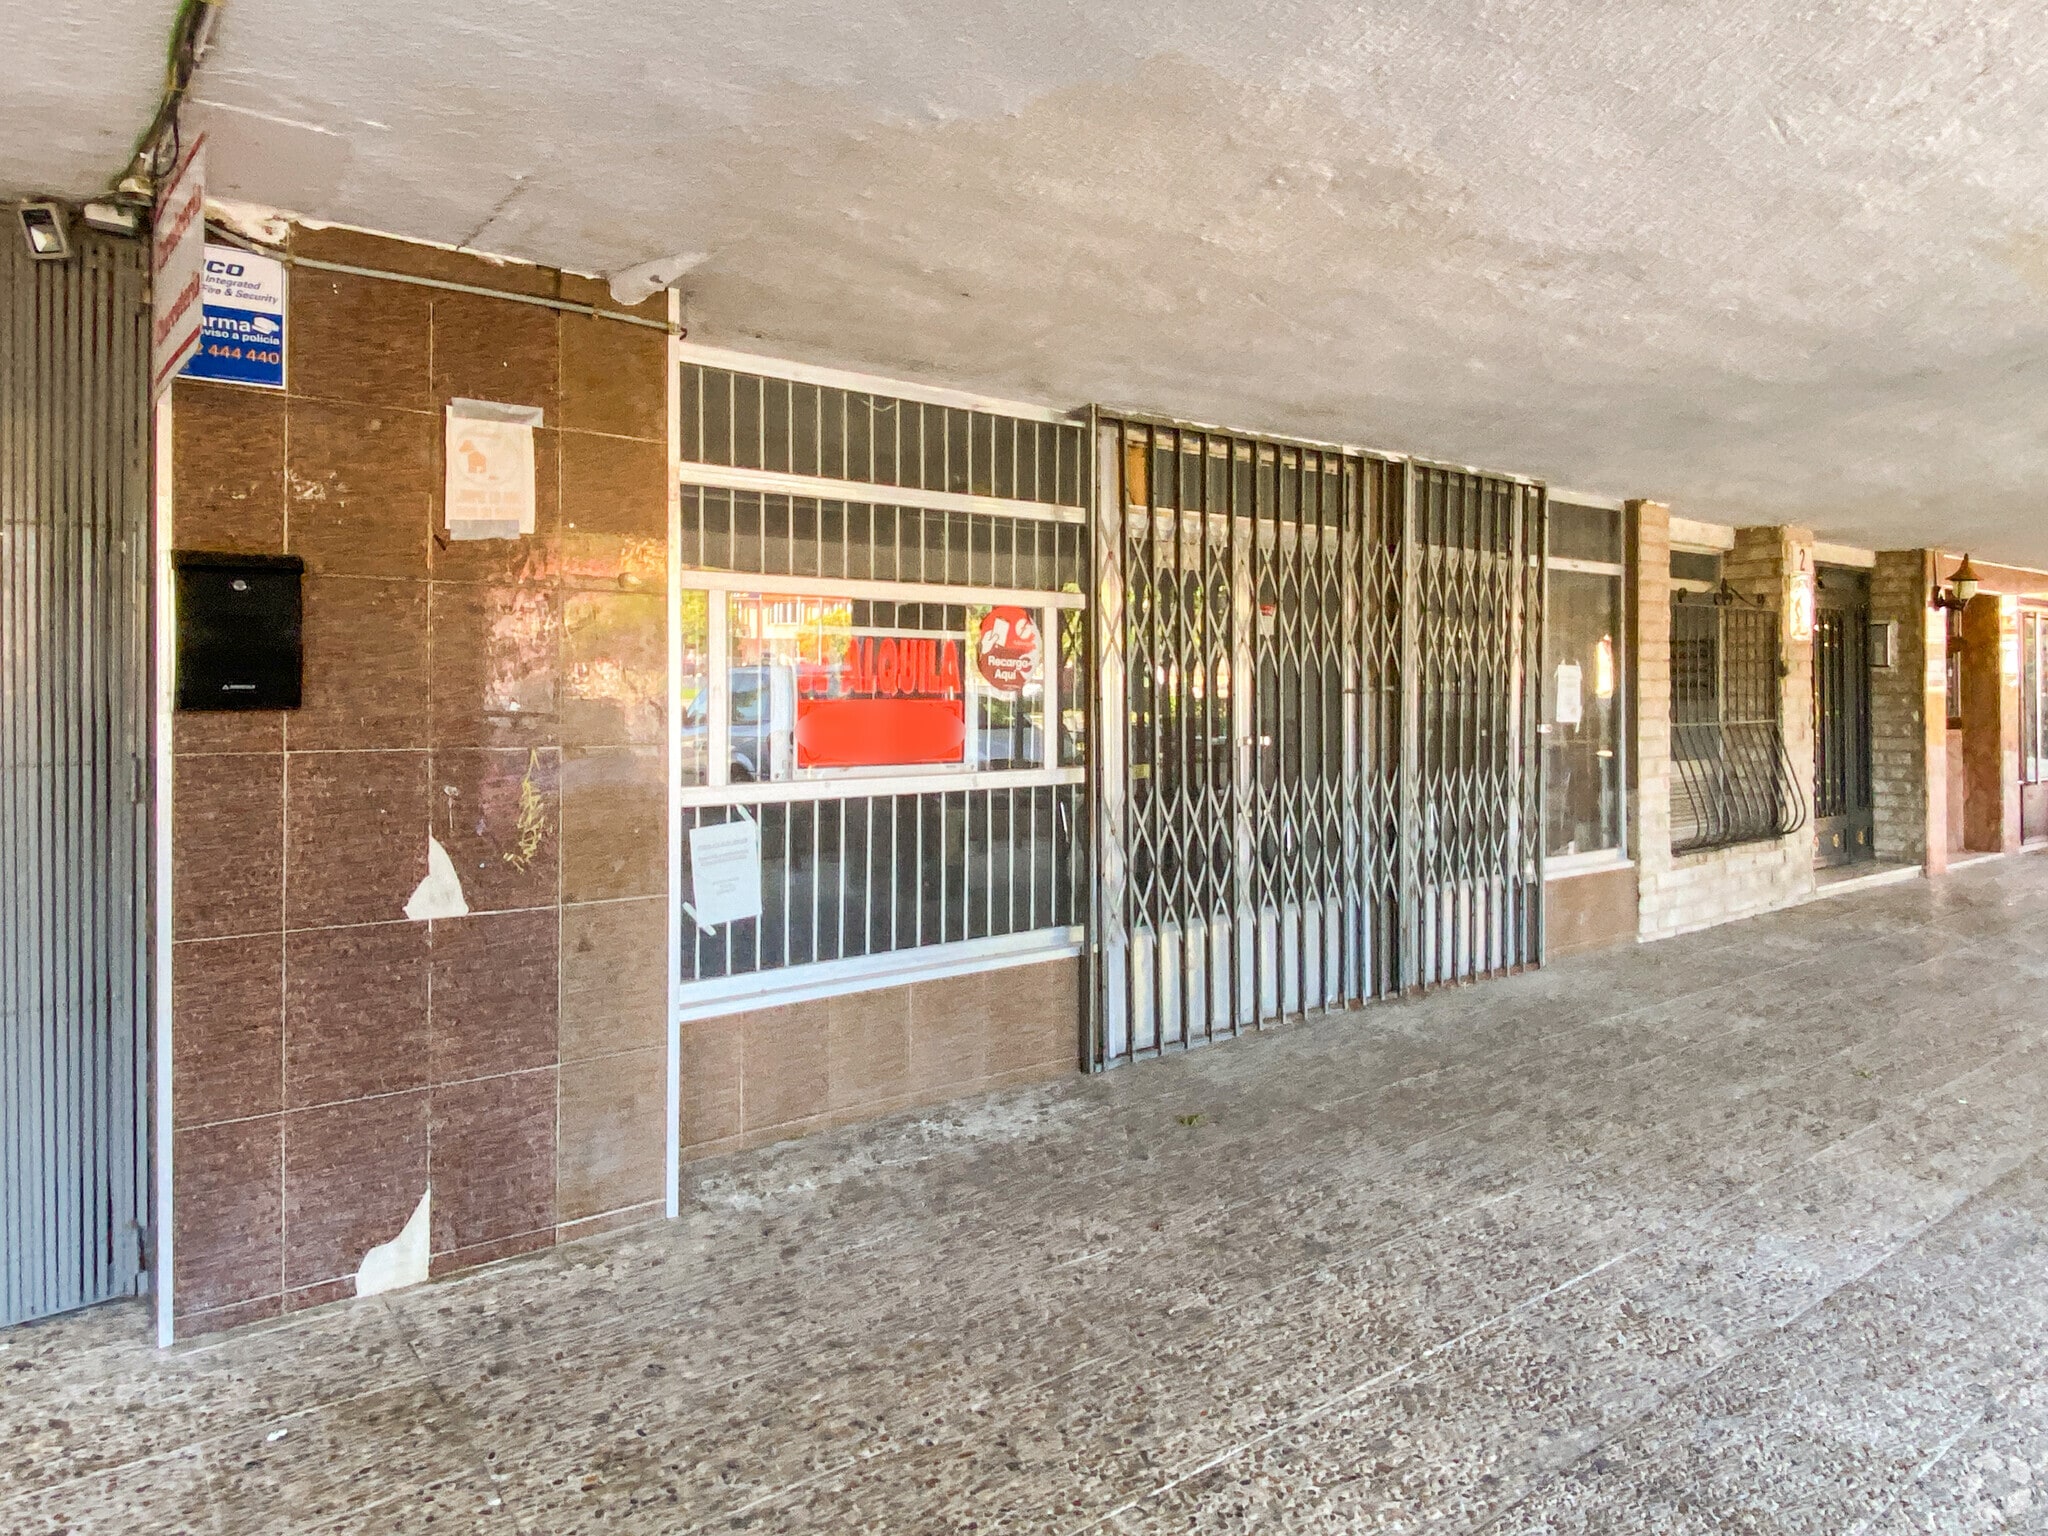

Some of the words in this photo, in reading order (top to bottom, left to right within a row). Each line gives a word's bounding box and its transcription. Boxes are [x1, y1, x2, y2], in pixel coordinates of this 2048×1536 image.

[203, 259, 244, 277] CO
[205, 275, 262, 290] Integrated
[224, 288, 234, 297] &
[235, 290, 279, 304] Security
[232, 332, 240, 340] a
[208, 344, 242, 360] 444
[246, 348, 280, 365] 440
[1799, 548, 1806, 572] 2
[840, 635, 961, 697] ALQUILA
